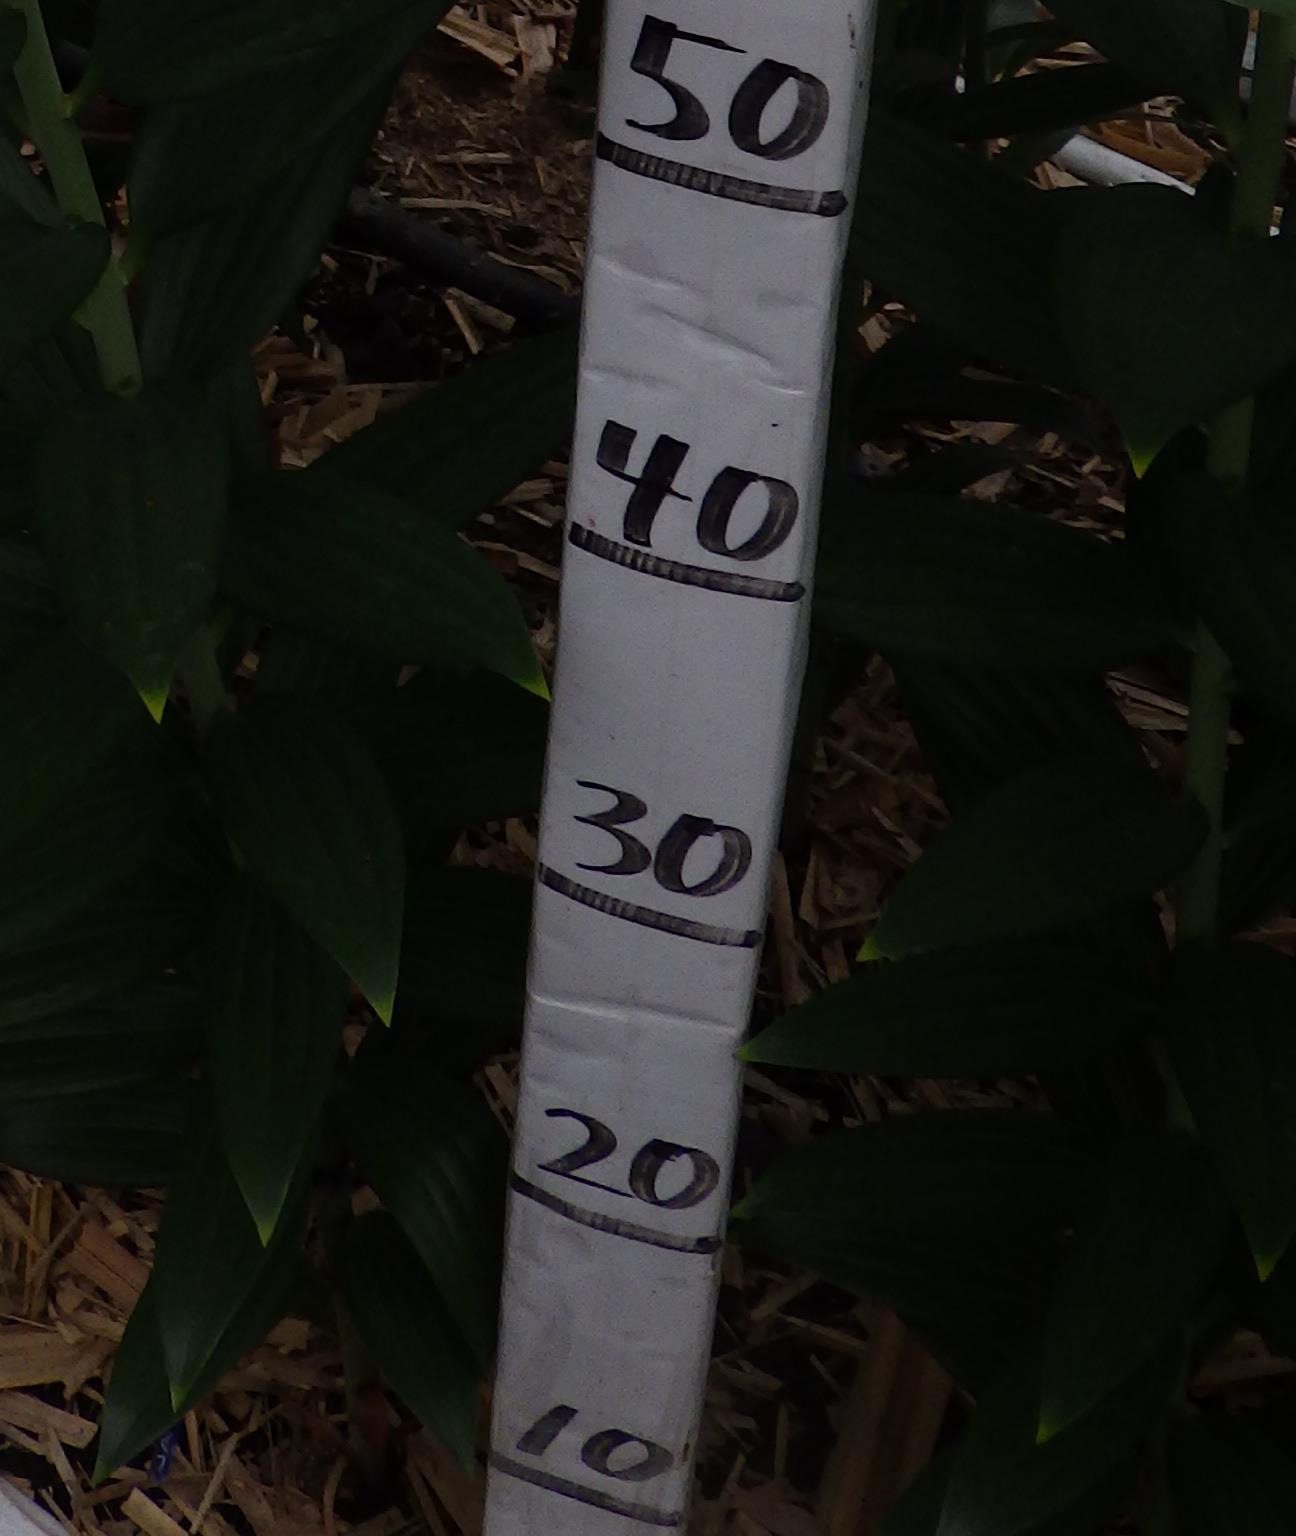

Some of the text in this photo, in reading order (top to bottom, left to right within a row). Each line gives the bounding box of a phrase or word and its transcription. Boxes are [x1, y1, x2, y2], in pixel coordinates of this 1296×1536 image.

[625, 15, 829, 160] 50
[595, 419, 799, 561] 40
[575, 780, 752, 897] 30
[538, 1108, 719, 1210] 20
[517, 1405, 676, 1482] 10
